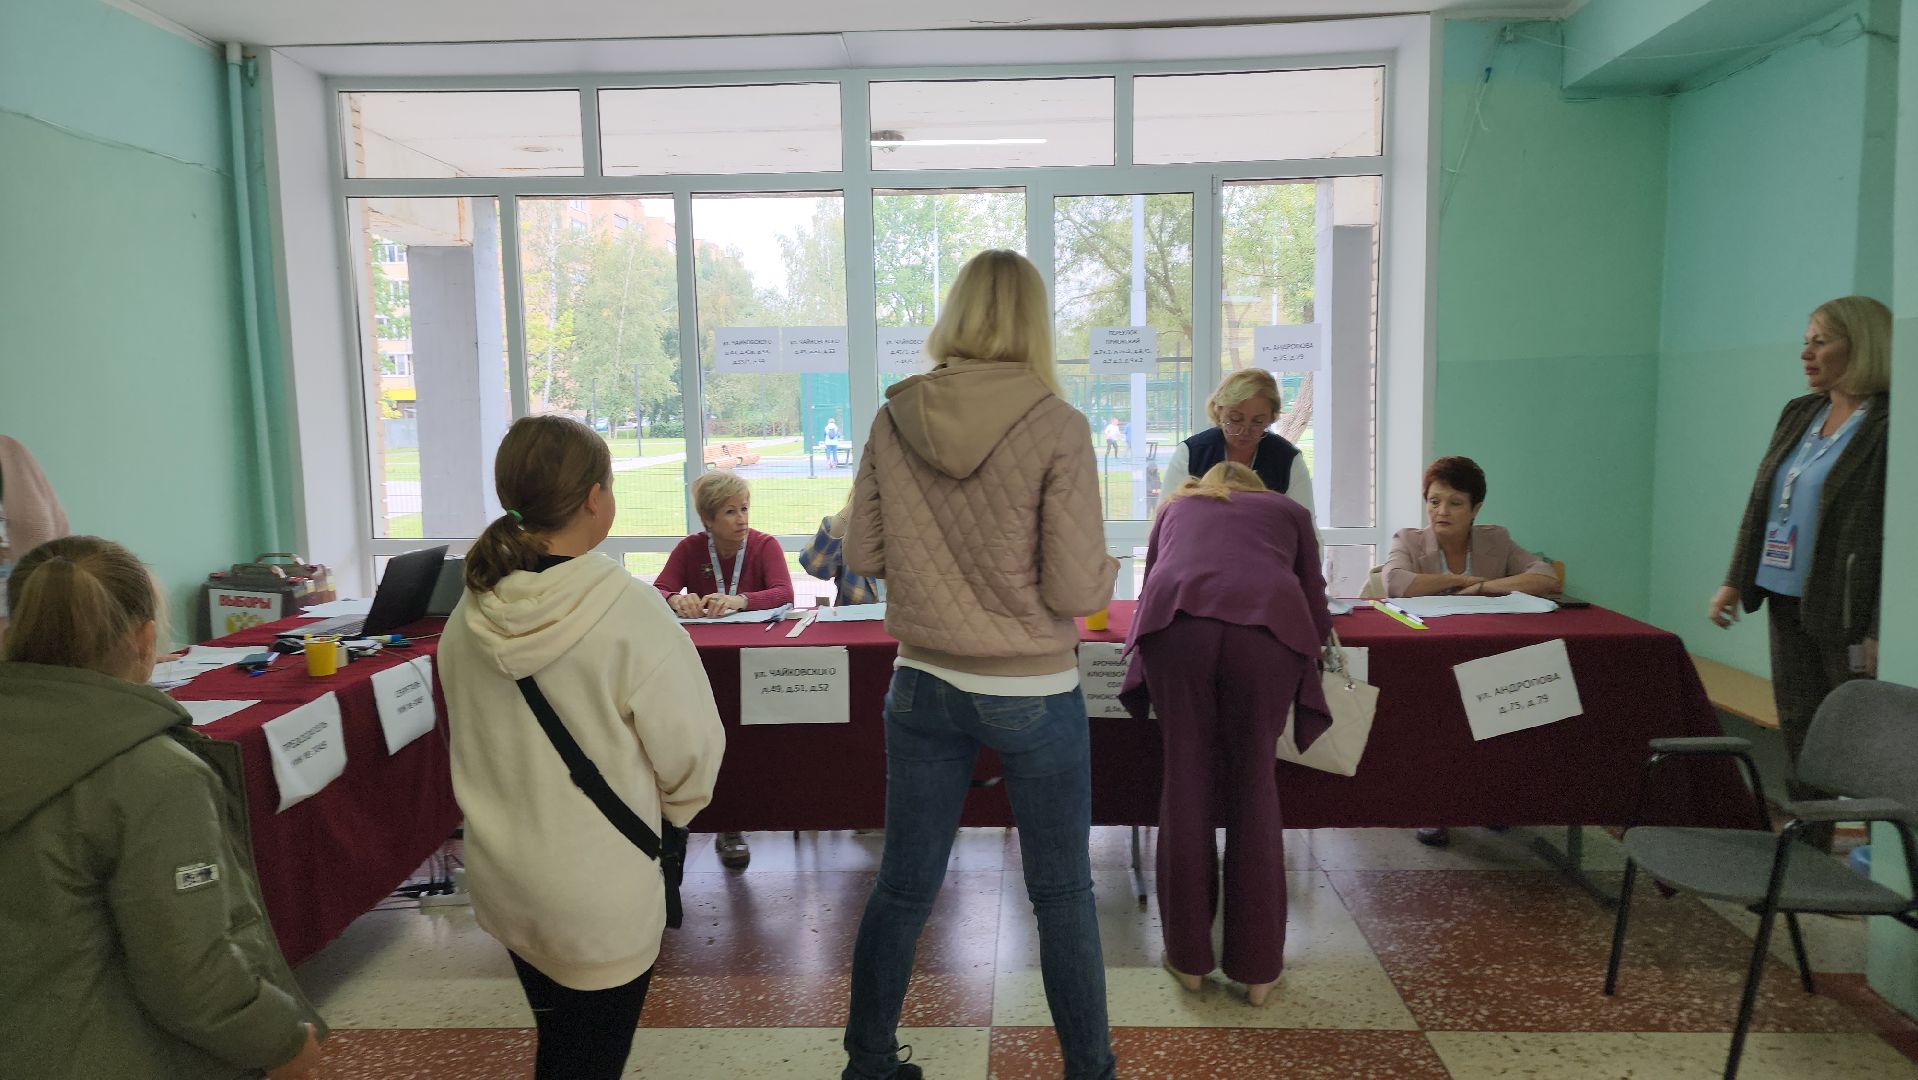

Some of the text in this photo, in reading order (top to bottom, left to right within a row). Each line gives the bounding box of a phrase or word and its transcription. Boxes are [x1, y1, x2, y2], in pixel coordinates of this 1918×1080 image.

[1273, 342, 1314, 350] АНДРОПОВА
[218, 594, 272, 610] ВЫБОРЫ
[754, 667, 837, 680] ул. ЧАЙКОВСКОГО
[1475, 672, 1562, 702] ул. АНДРОПОВА
